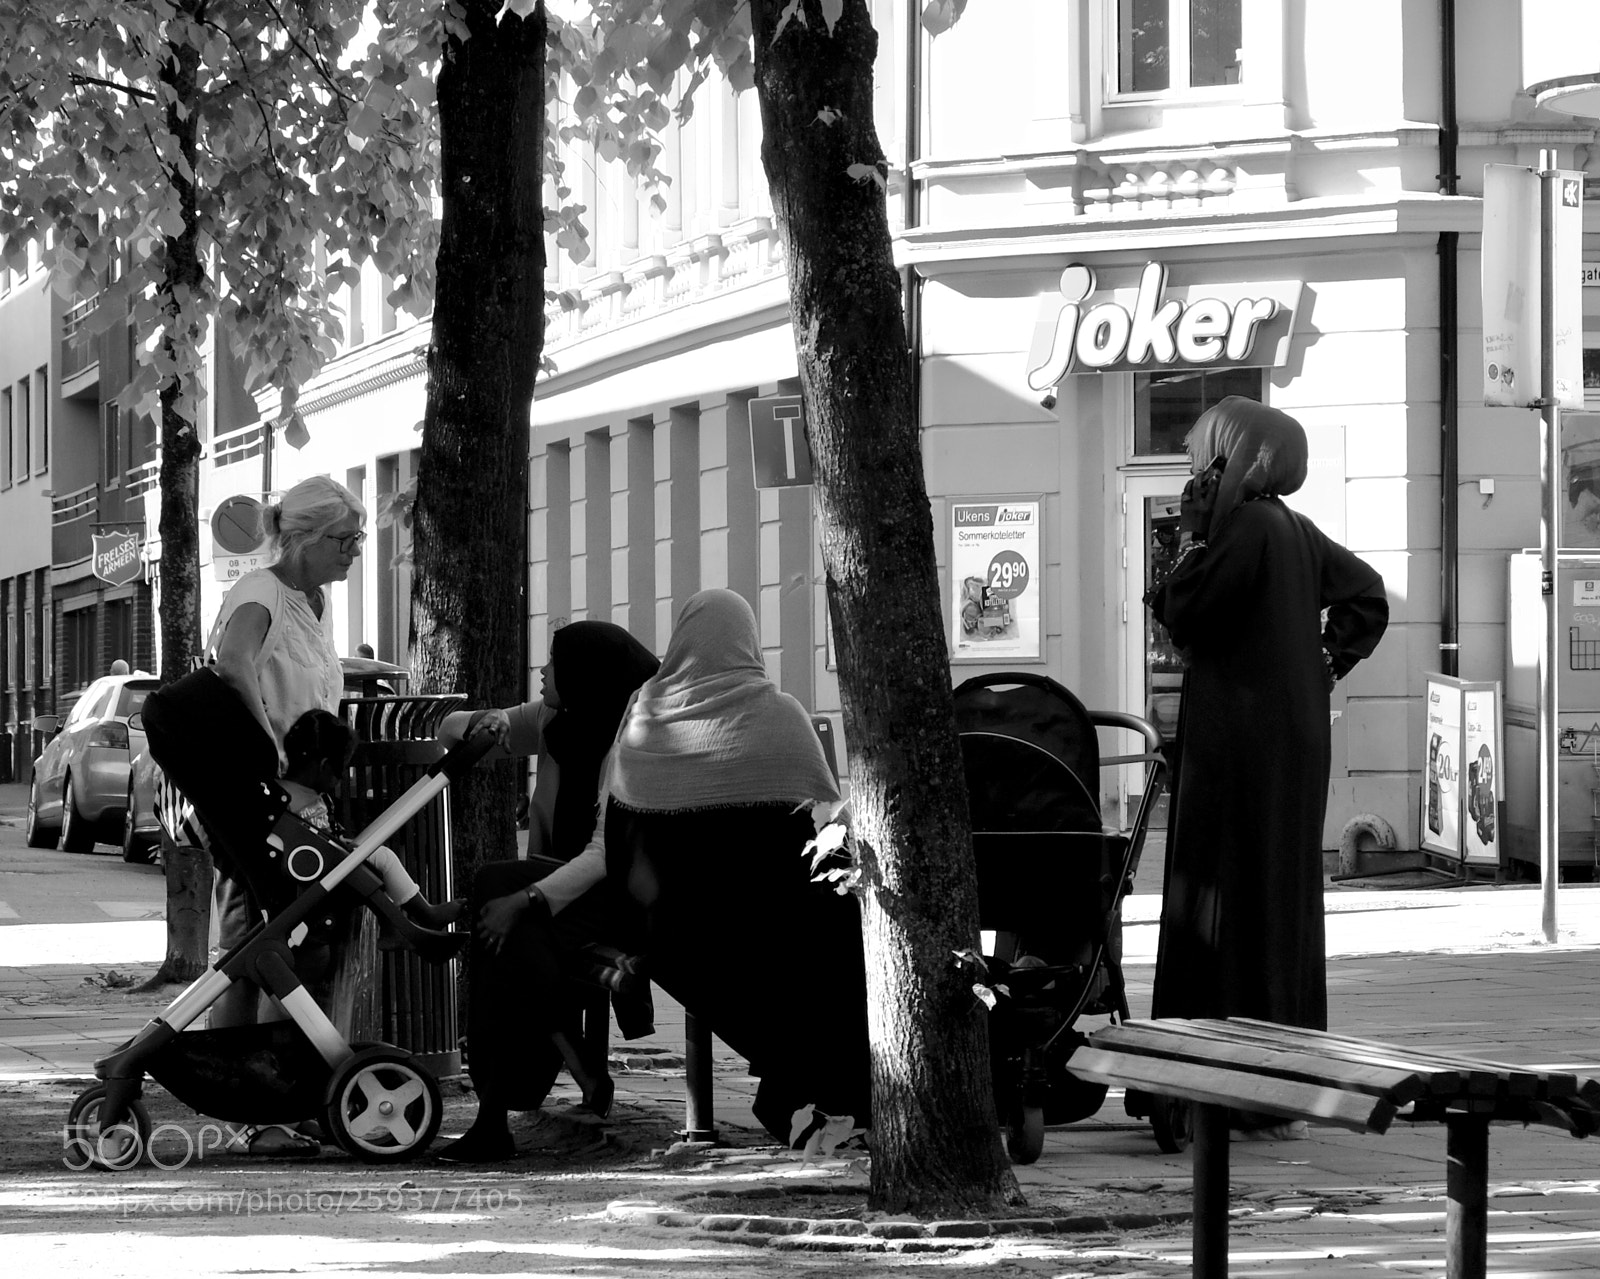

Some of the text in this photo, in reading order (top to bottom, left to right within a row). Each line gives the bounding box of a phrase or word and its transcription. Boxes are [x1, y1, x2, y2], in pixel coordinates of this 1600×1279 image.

[1028, 261, 1279, 391] joker
[957, 508, 1031, 522] Ukens joker
[958, 530, 1026, 541] Sommerkoteletter
[102, 549, 136, 577] ARMEEN
[229, 559, 239, 567] 08
[1438, 753, 1450, 780] 20
